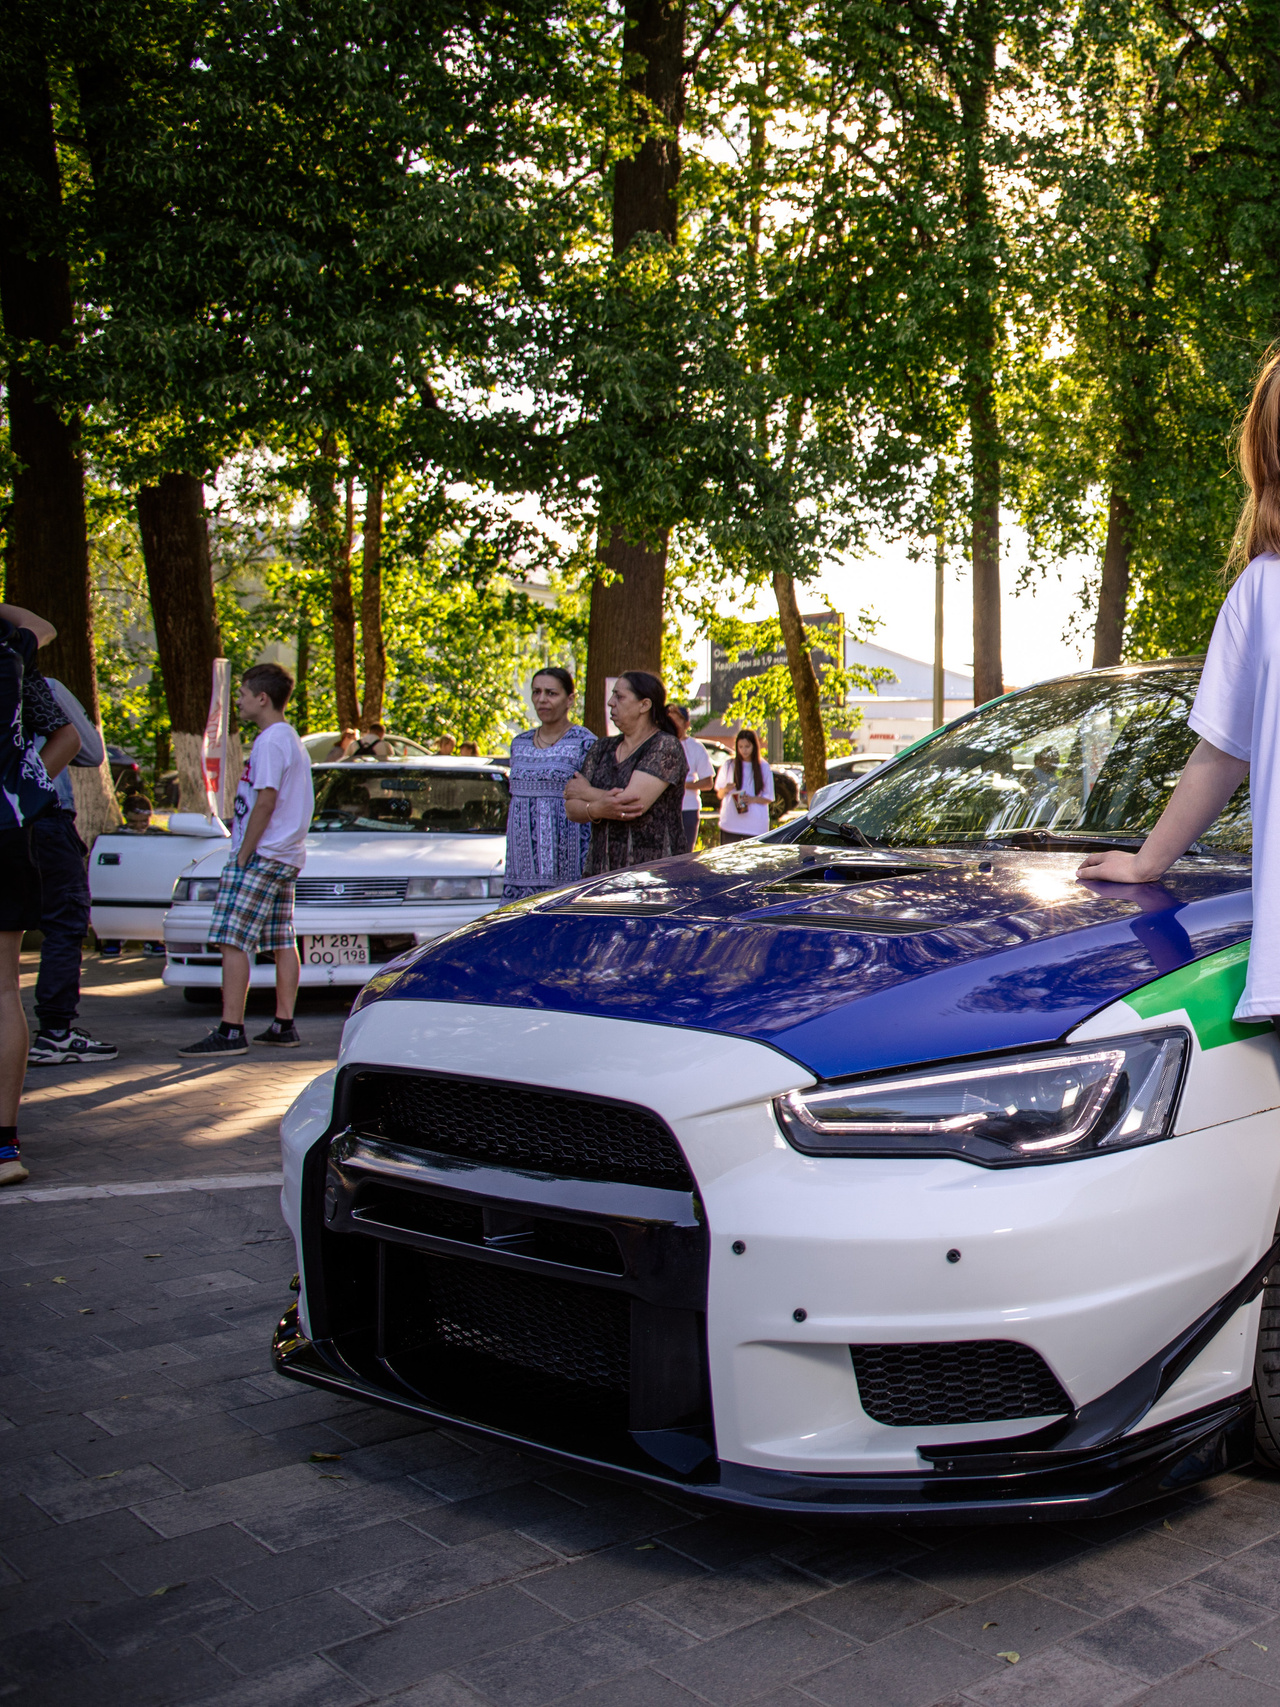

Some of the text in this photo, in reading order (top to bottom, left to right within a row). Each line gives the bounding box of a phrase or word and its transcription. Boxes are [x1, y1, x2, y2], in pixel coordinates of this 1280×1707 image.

[715, 658, 751, 671] Квартиры
[753, 659, 760, 667] за
[762, 656, 773, 667] 1,9
[312, 935, 358, 948] М 287
[343, 950, 366, 961] 198
